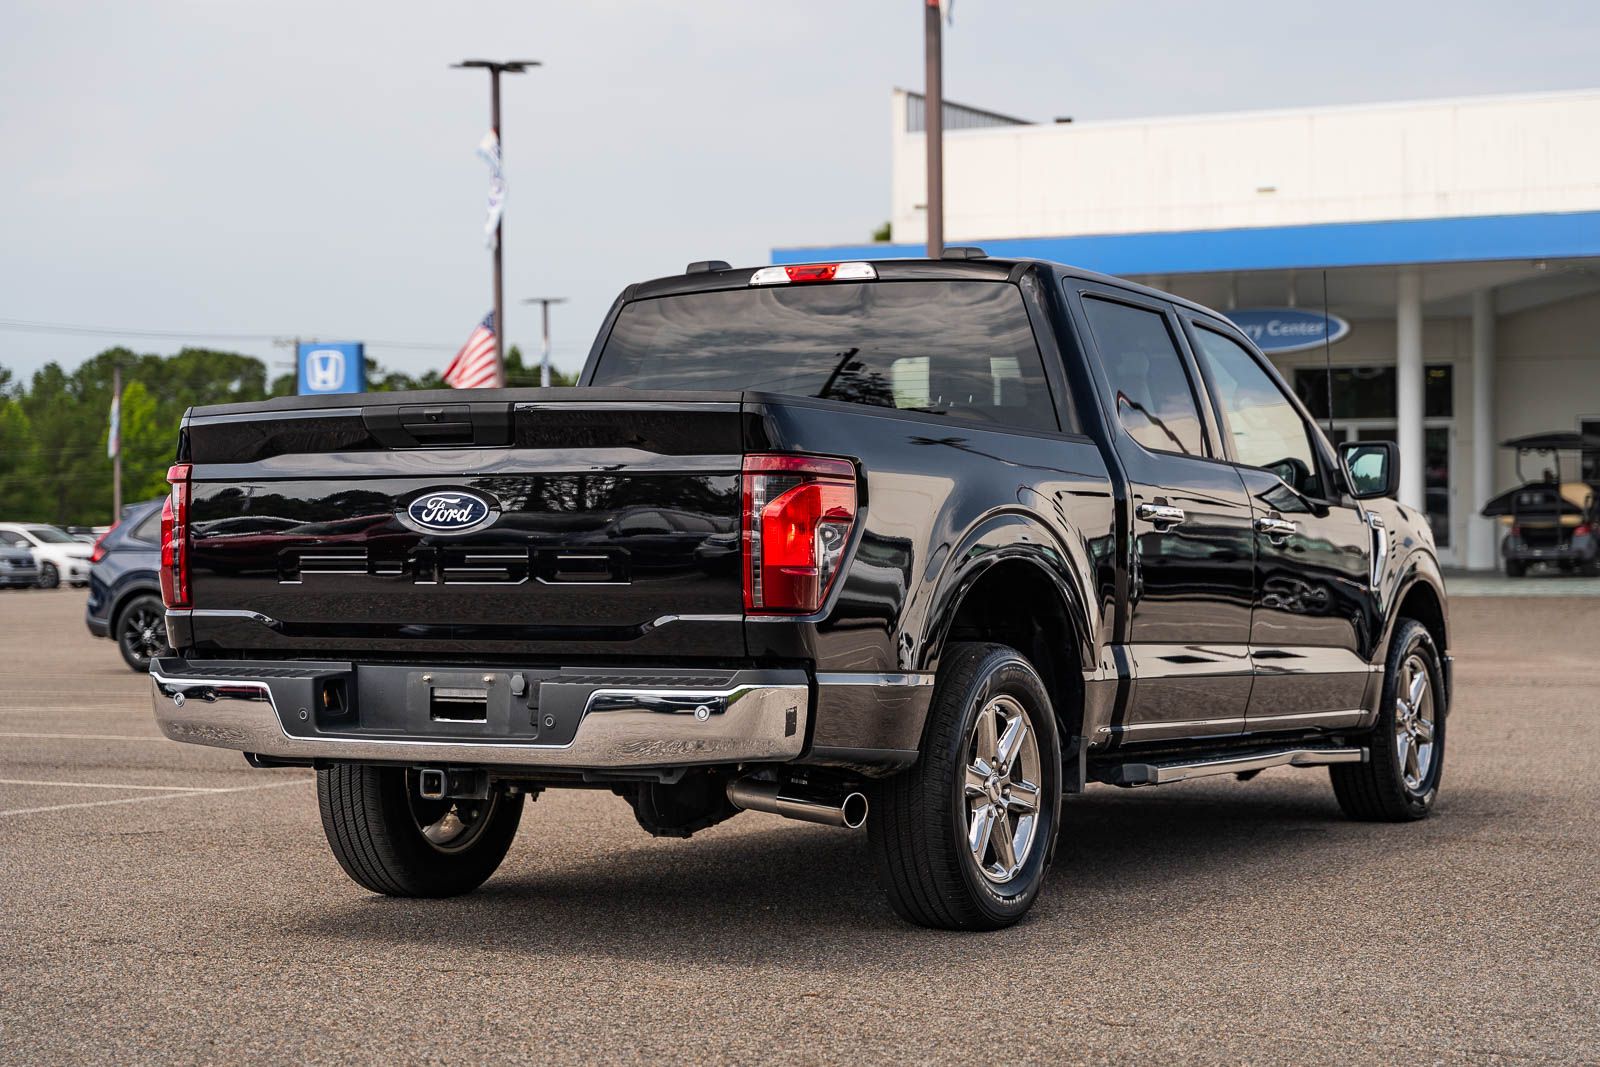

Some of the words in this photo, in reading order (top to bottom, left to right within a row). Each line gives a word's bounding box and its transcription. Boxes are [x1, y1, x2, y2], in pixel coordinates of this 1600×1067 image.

[1267, 320, 1323, 336] Center
[422, 497, 473, 522] Ford
[278, 546, 632, 585] F-150
